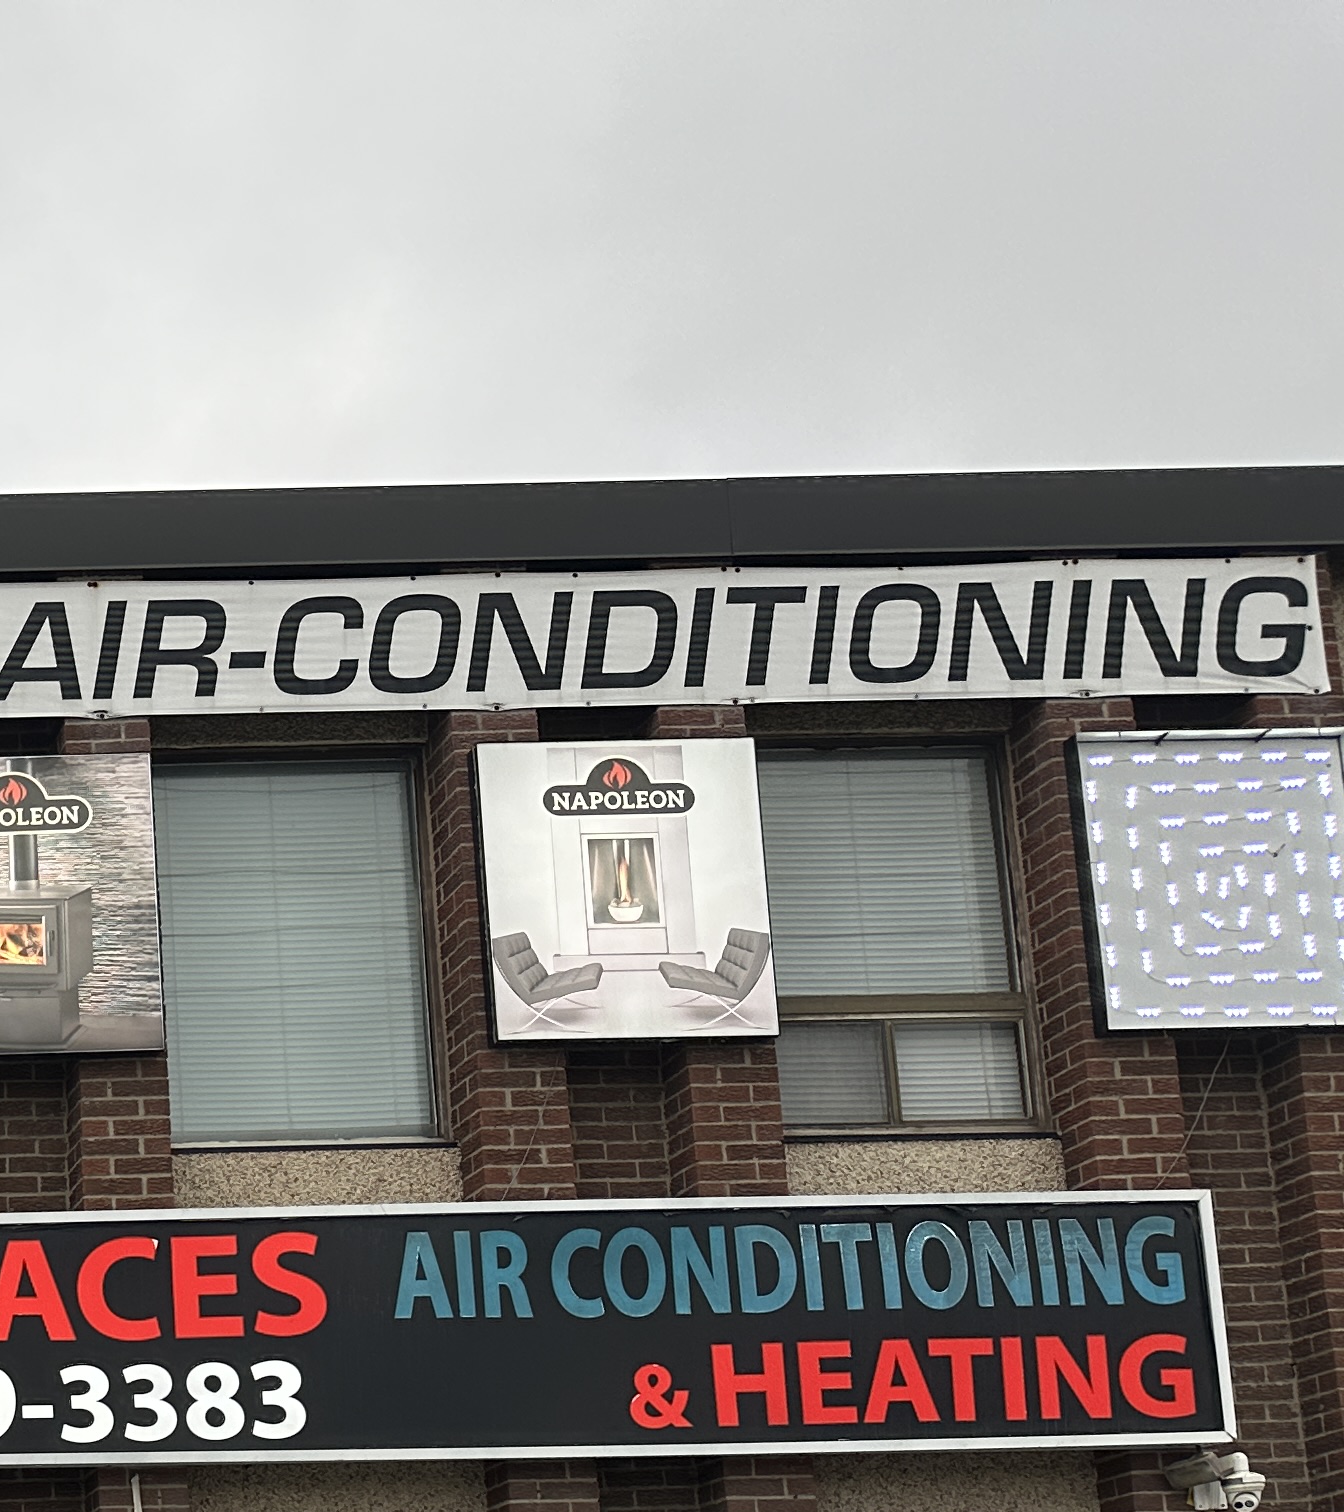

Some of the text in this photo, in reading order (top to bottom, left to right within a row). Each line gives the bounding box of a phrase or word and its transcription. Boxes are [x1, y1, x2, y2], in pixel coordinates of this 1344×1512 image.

[552, 790, 685, 811] NAPOLEON
[393, 1216, 1186, 1320] AIR CONDITIONING
[629, 1333, 1197, 1429] & HEATING
